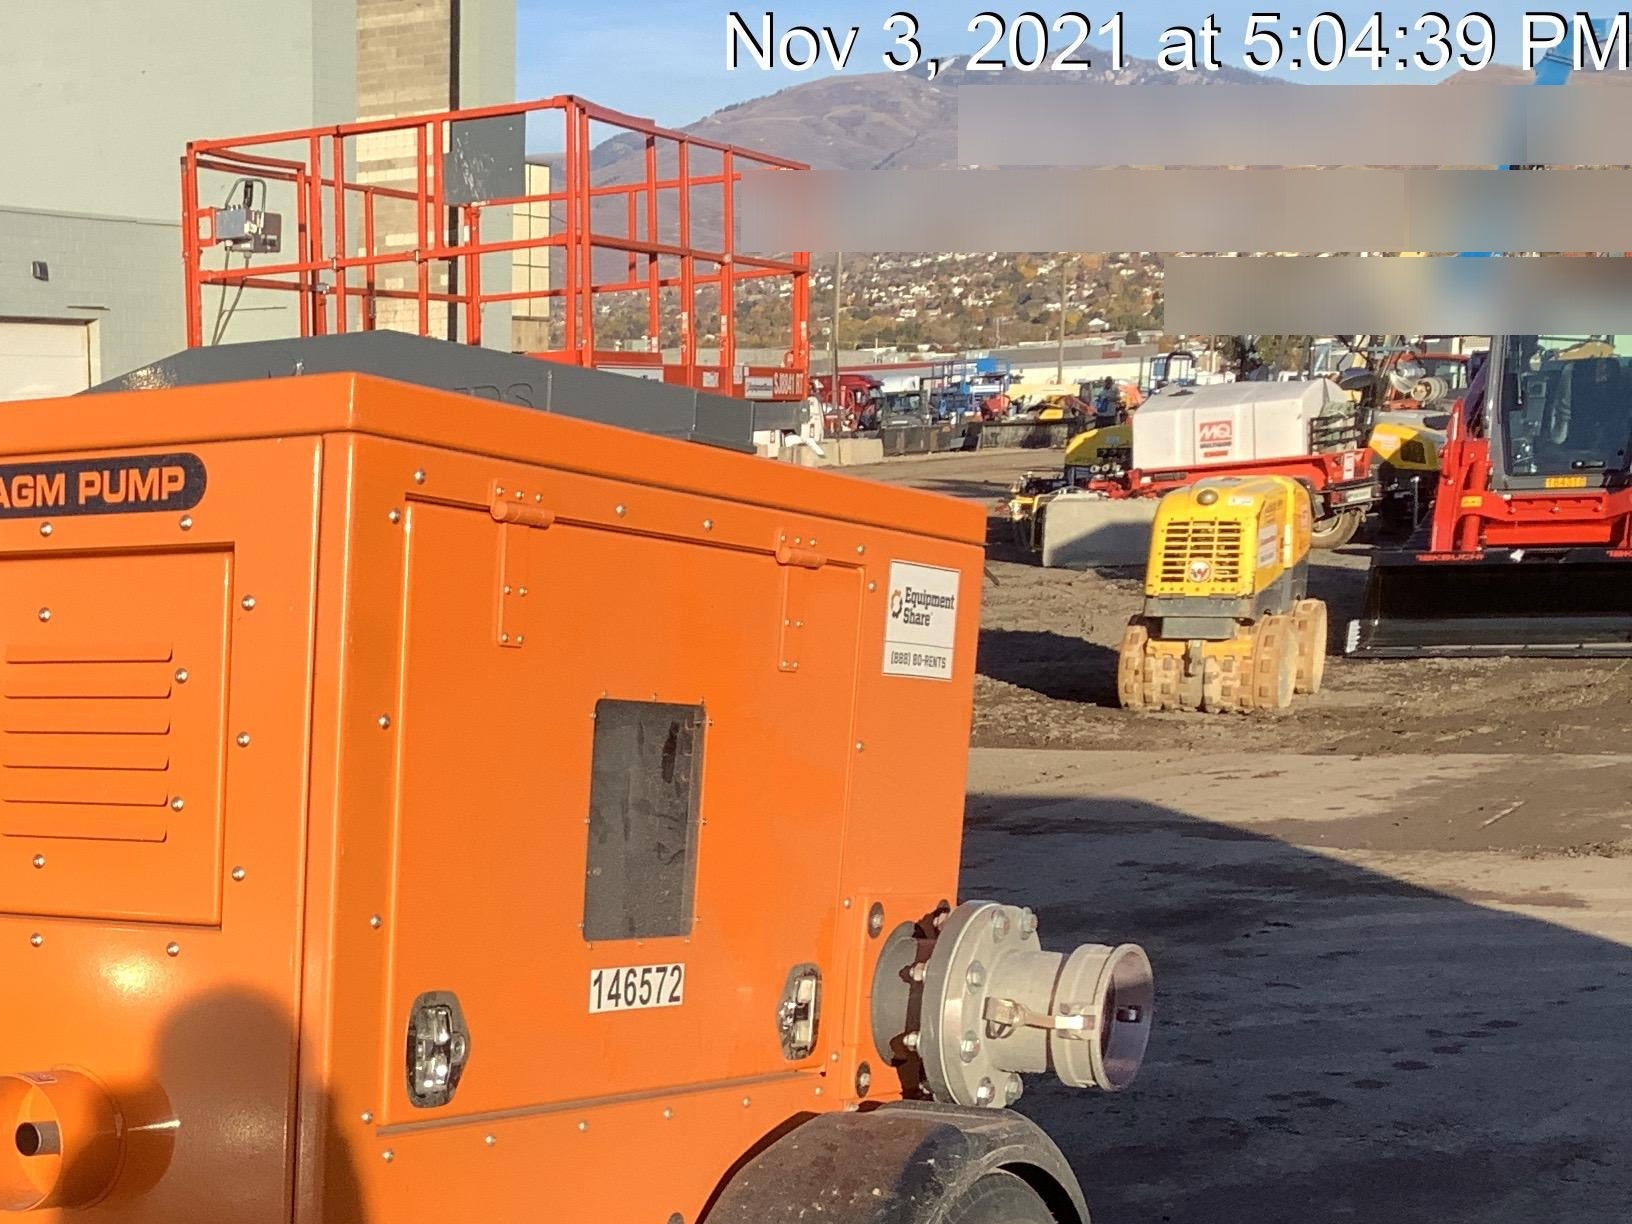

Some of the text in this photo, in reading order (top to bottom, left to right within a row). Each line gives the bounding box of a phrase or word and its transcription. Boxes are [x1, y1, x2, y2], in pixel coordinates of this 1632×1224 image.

[78, 465, 185, 505] PUMP
[905, 586, 956, 611] Equipment
[903, 607, 932, 627] Share
[593, 964, 683, 1010] 146572
